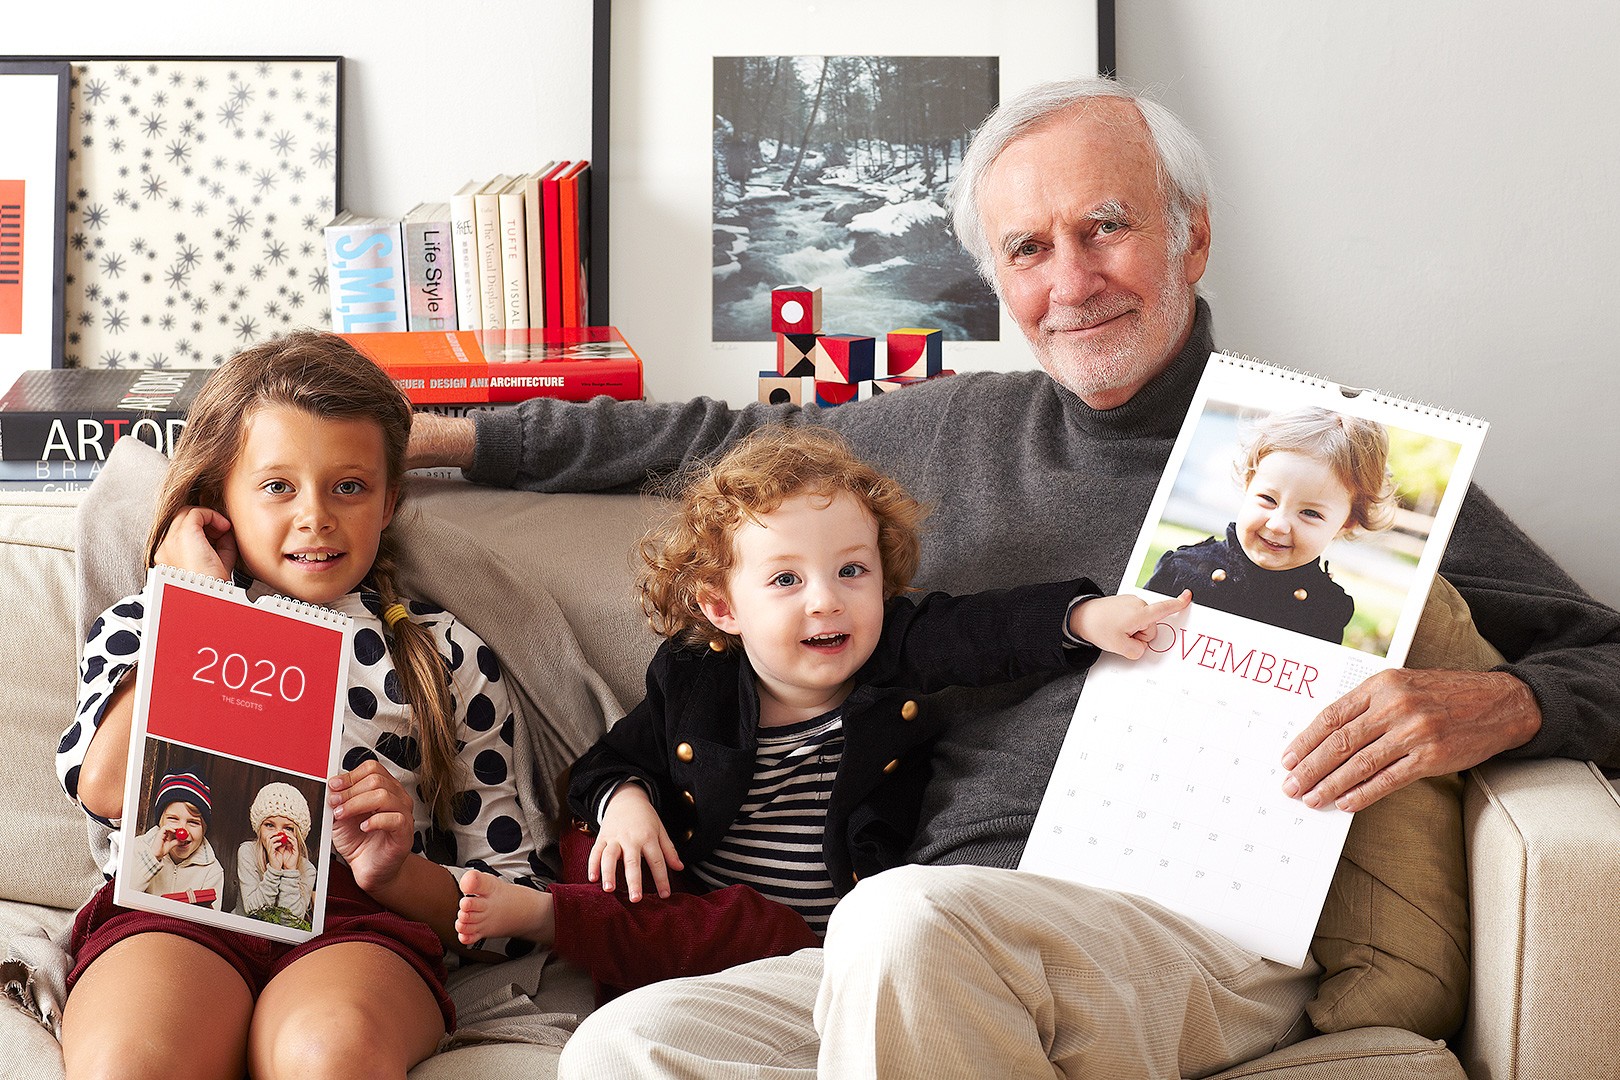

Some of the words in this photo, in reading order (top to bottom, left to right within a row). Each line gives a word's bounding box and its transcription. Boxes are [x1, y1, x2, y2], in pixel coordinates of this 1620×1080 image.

[423, 230, 441, 263] Life
[484, 221, 494, 240] The
[507, 219, 517, 259] TUFTE
[485, 243, 497, 271] Visual
[421, 268, 443, 313] Style
[485, 275, 498, 309] Display
[510, 279, 520, 325] VISUAL
[489, 313, 500, 324] of
[398, 379, 425, 389] EUER
[429, 378, 467, 388] DESIGN
[490, 377, 565, 387] ARCHITECTURE
[192, 647, 305, 702] 2020
[1147, 622, 1319, 698] OVEMBER
[222, 695, 235, 705] THE
[236, 698, 263, 711] SCOTTS
[1127, 725, 1133, 733] 5
[1162, 736, 1168, 744] 6
[1198, 746, 1205, 754] 7
[1233, 757, 1240, 766] 8
[1270, 768, 1276, 776] 9
[1282, 730, 1289, 740] 2
[1079, 752, 1089, 760] 11
[1114, 763, 1125, 771] 12
[1150, 774, 1160, 782] 13
[1257, 807, 1267, 815] 16
[1066, 789, 1076, 797] 18
[1136, 810, 1147, 819] 20
[1171, 821, 1182, 830] 21
[1207, 833, 1218, 841] 22
[1243, 844, 1255, 852] 23
[1280, 855, 1290, 864] 24
[1052, 826, 1063, 834] 25
[1087, 837, 1098, 845] 26
[1159, 859, 1170, 867] 28
[1231, 881, 1242, 890] 30
